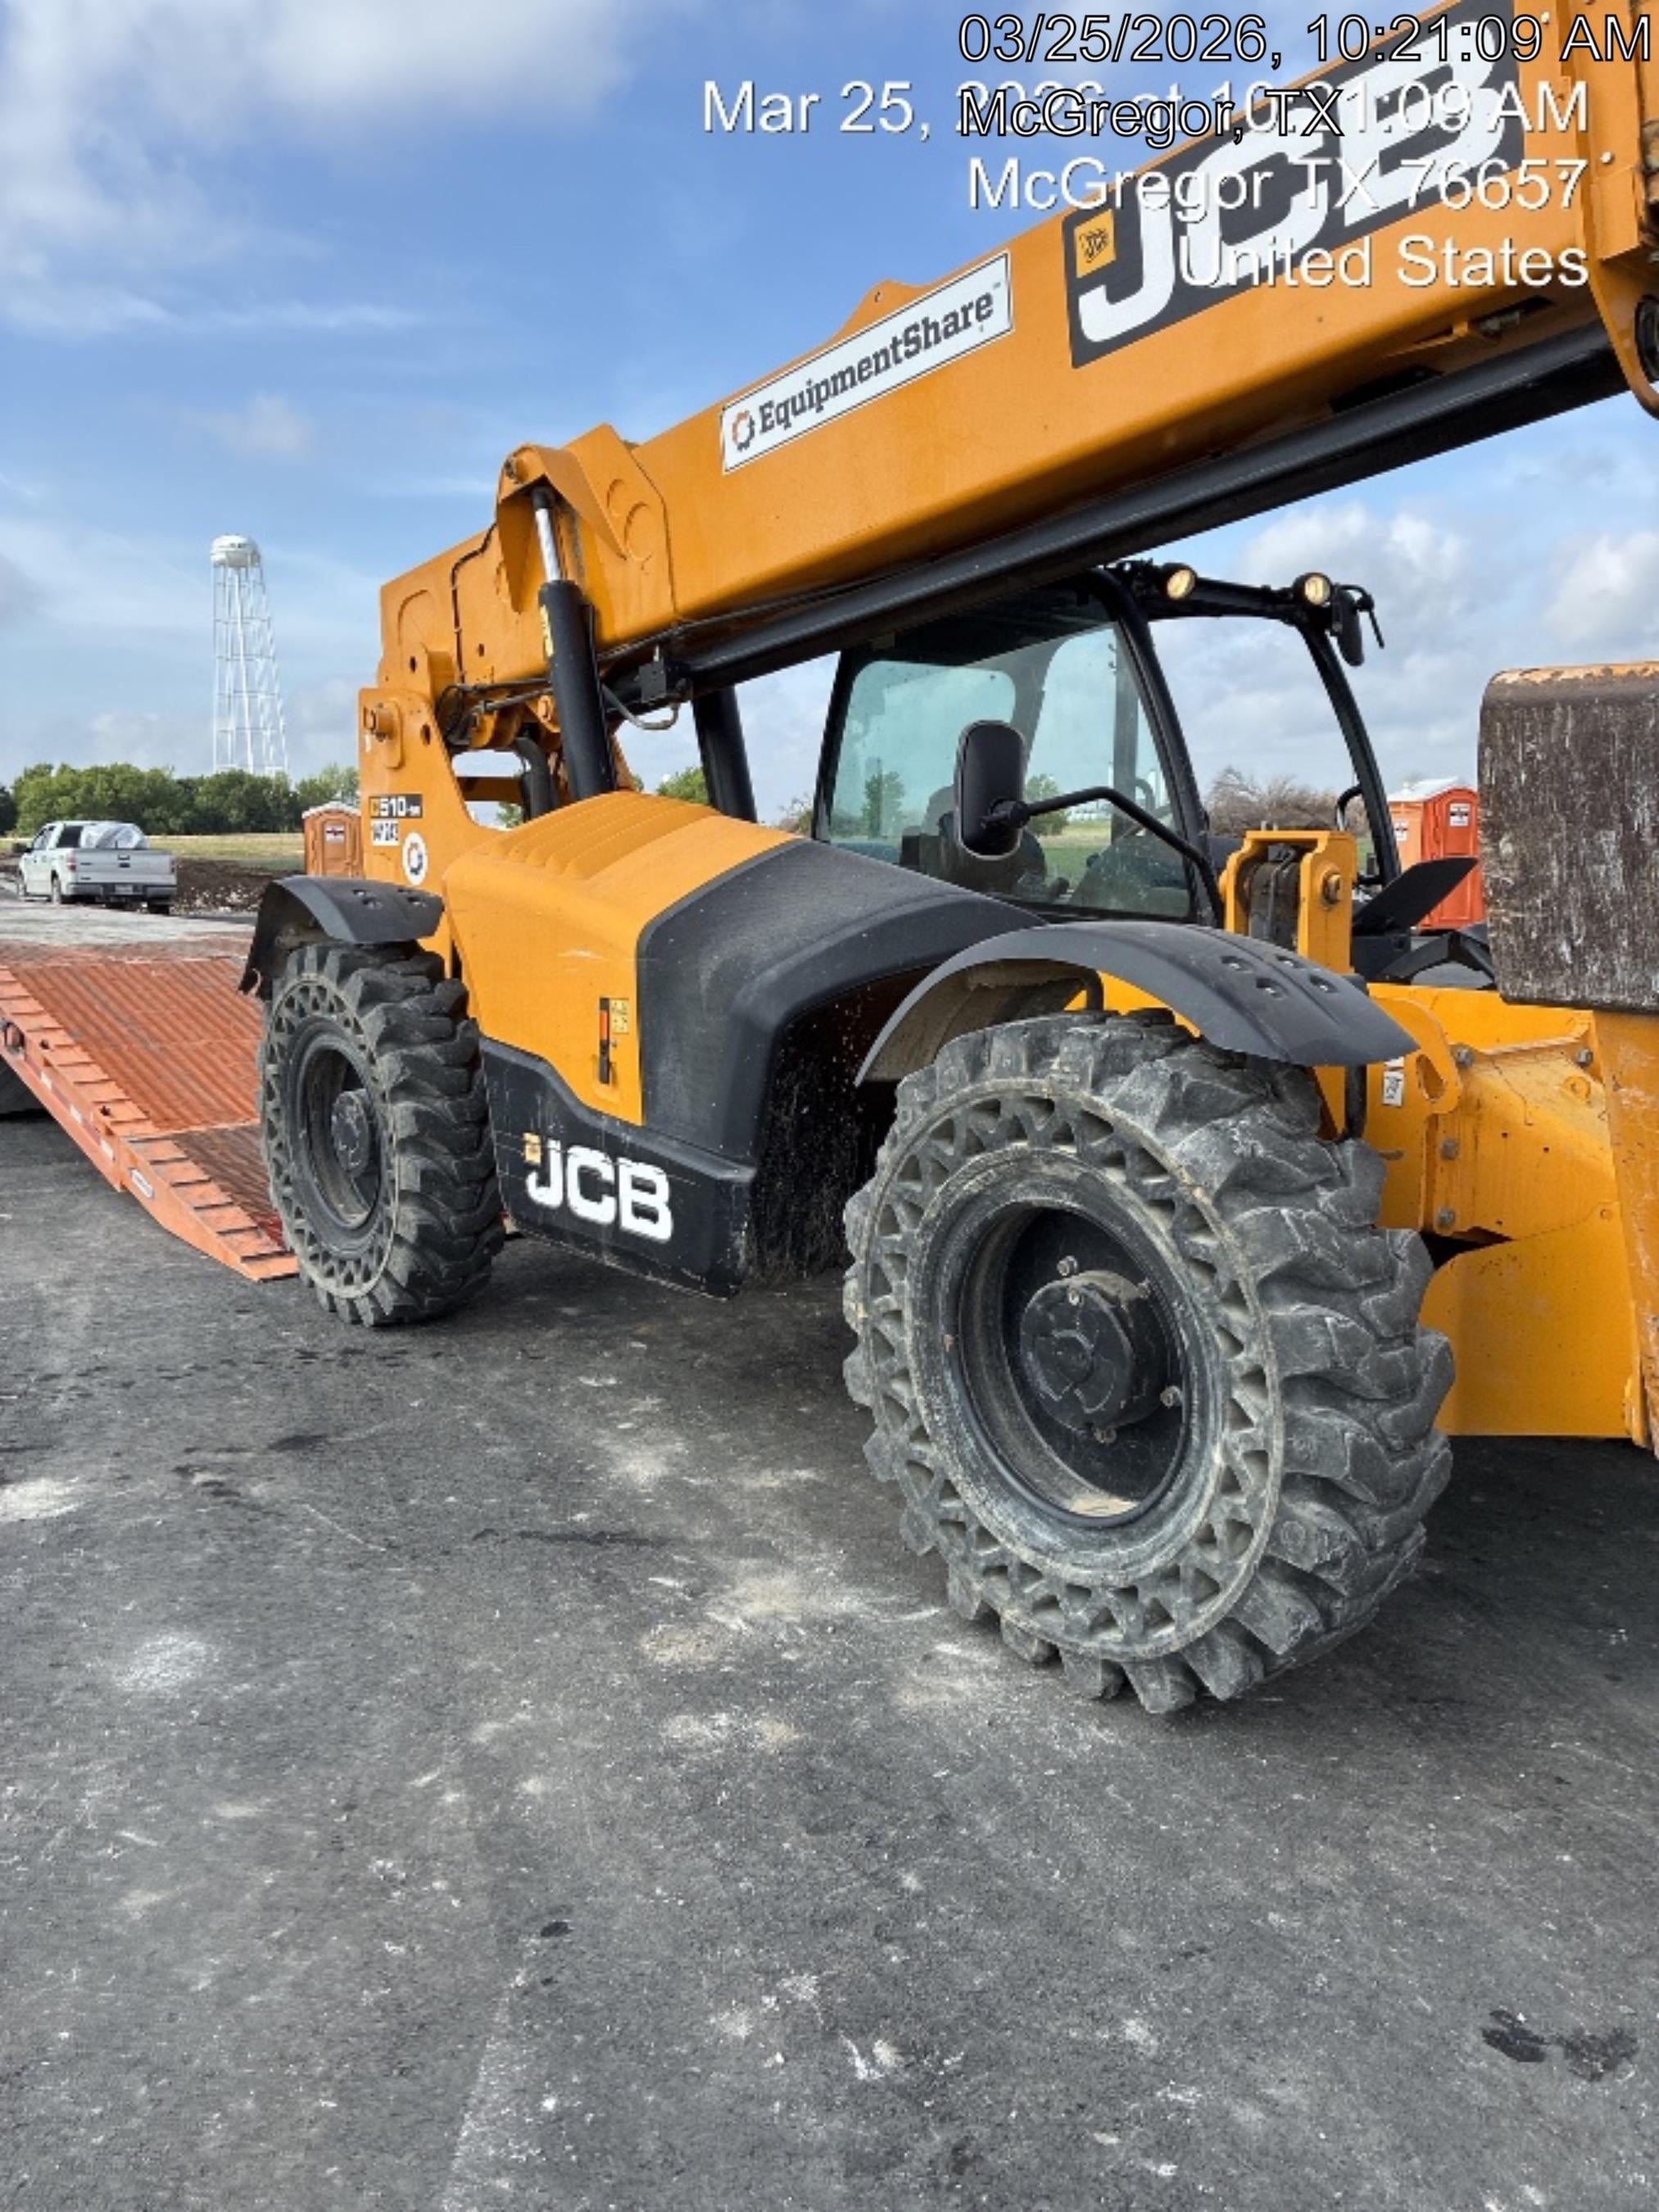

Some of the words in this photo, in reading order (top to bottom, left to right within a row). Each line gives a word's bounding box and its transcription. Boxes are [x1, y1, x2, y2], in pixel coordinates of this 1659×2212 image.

[1078, 21, 1507, 342] JCB
[759, 292, 994, 435] EquipmentShare
[525, 1139, 673, 1243] JCB
